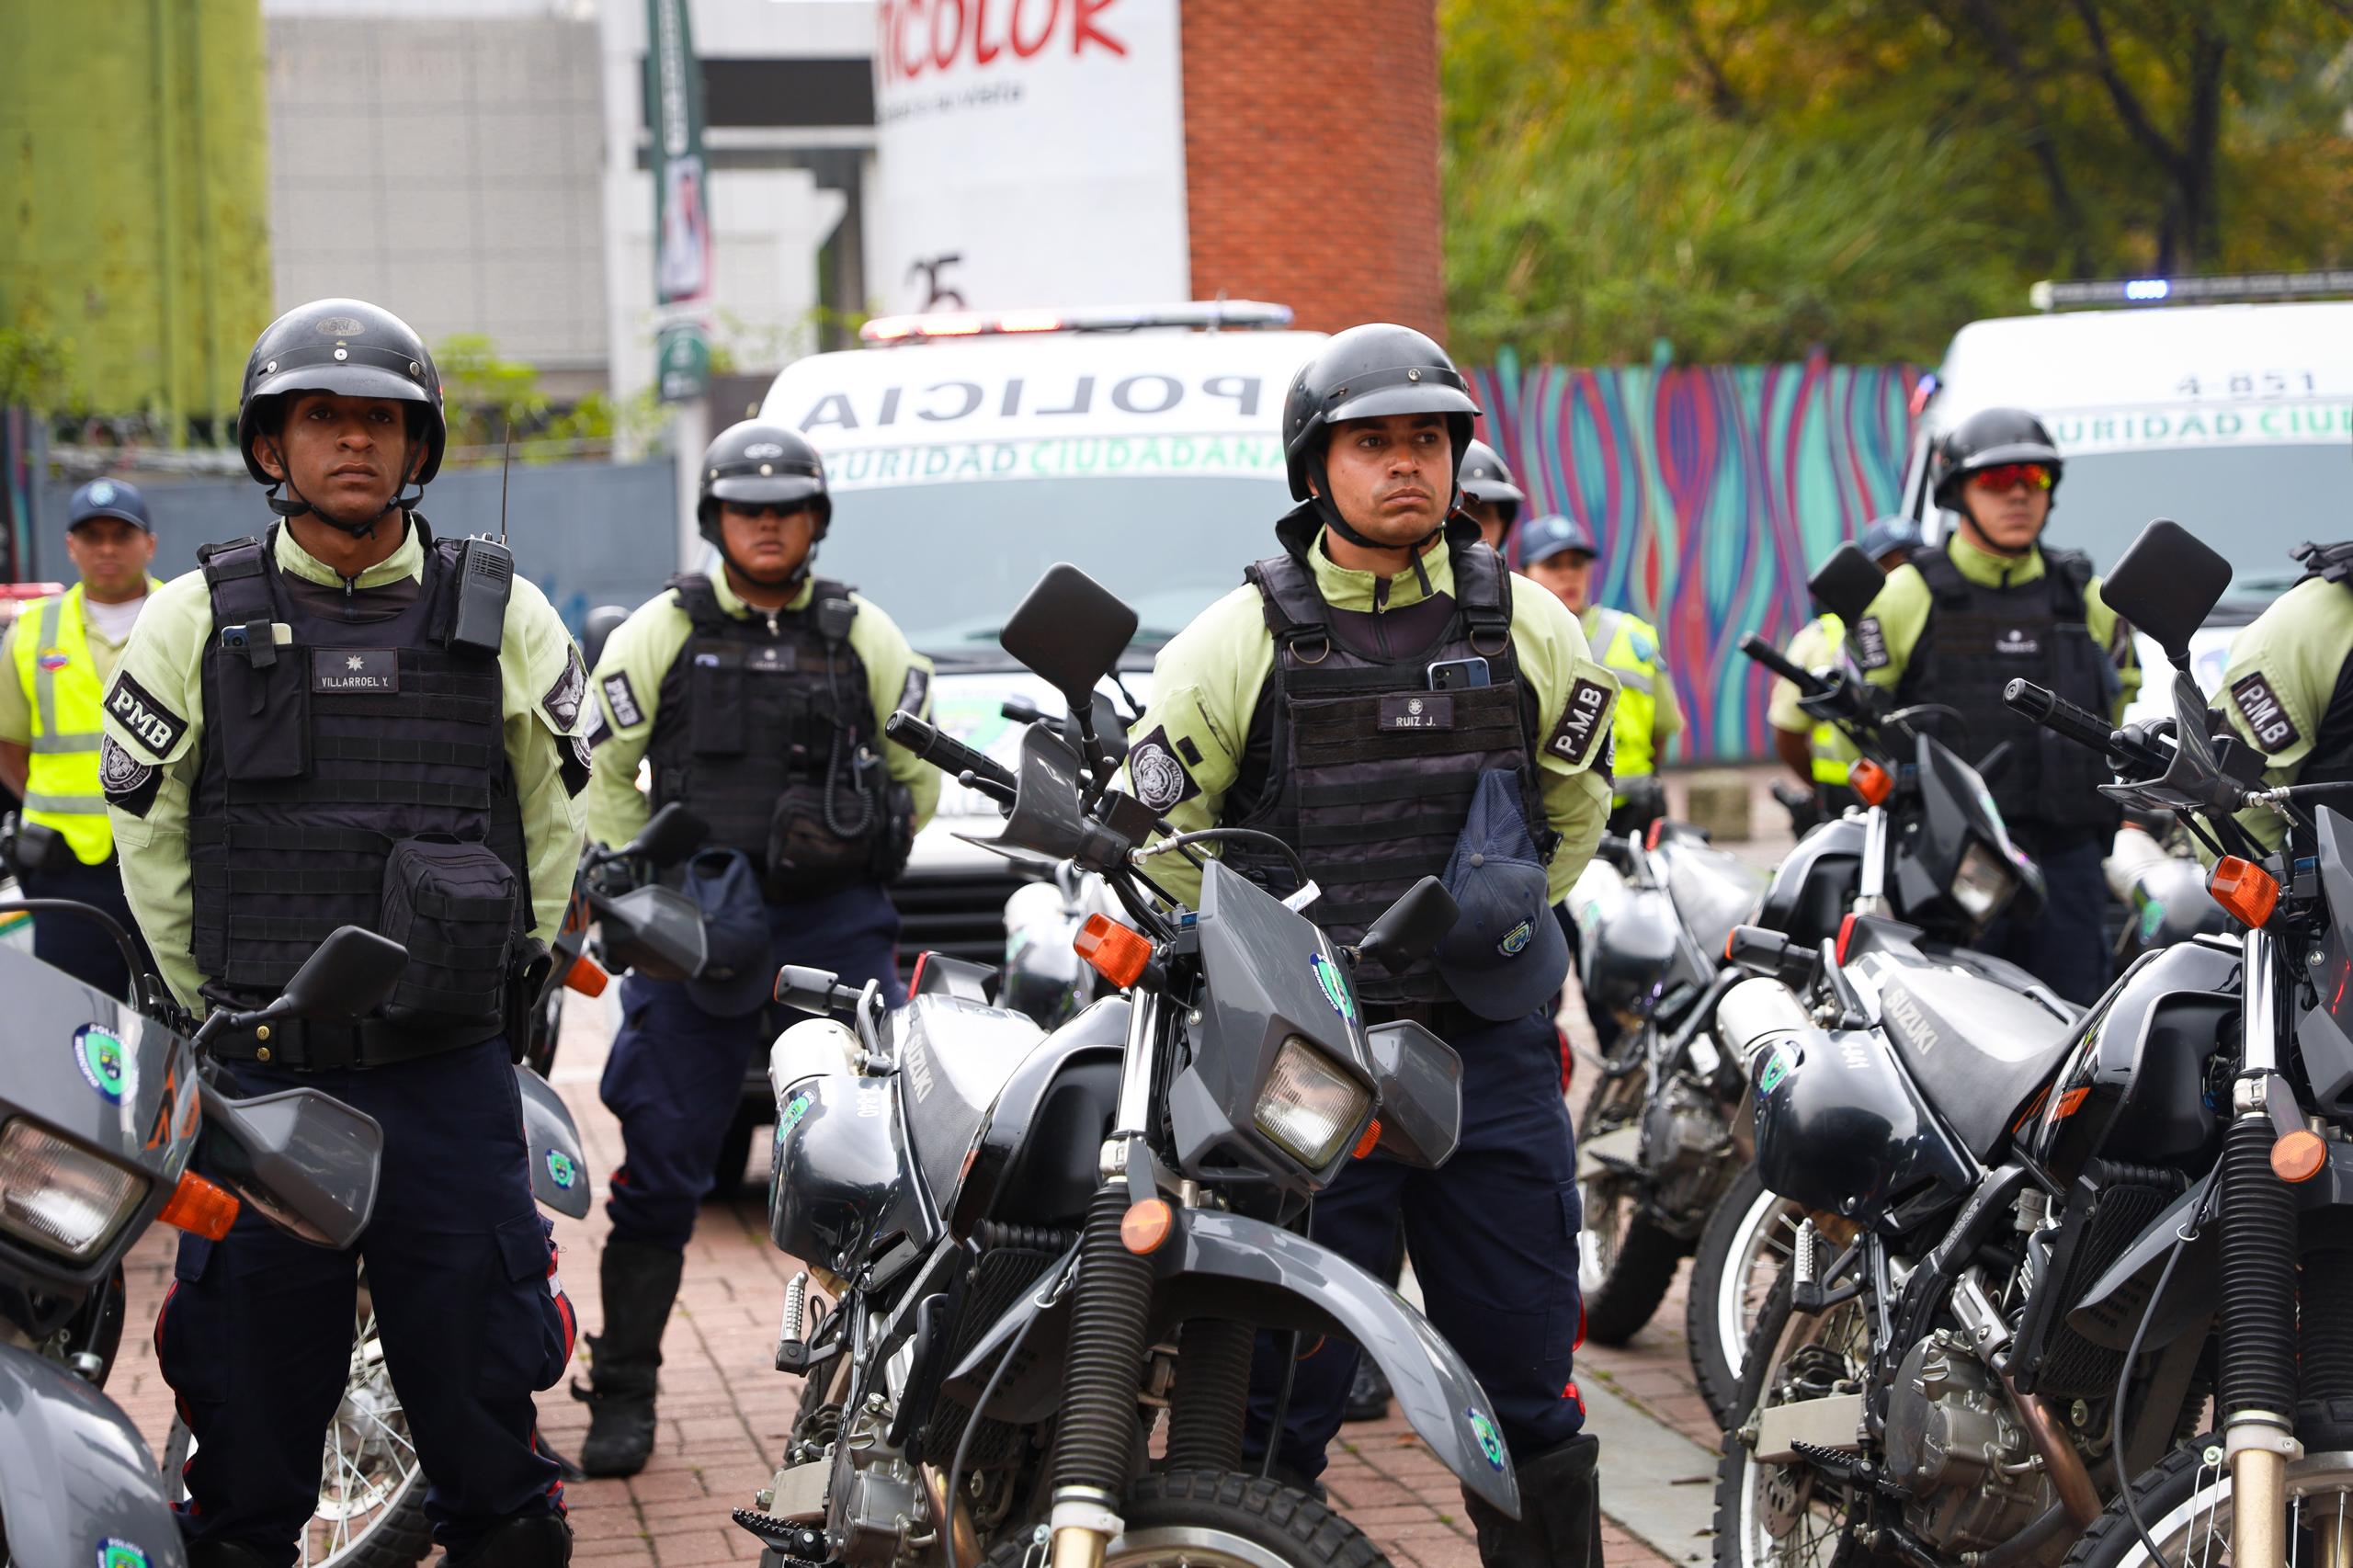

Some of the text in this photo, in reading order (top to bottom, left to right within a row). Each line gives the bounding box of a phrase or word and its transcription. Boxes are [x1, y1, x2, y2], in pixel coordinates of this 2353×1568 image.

[322, 676, 380, 687] VILLARROEL
[111, 687, 173, 749] PMB
[1396, 715, 1436, 727] RUIZ J.
[1555, 687, 1602, 756] P.M.B
[2237, 684, 2290, 744] P.M.B
[1312, 964, 1339, 1011] MUNICIPIO
[1884, 988, 1938, 1056] SUZUKI
[904, 1032, 935, 1104] SUZUKI
